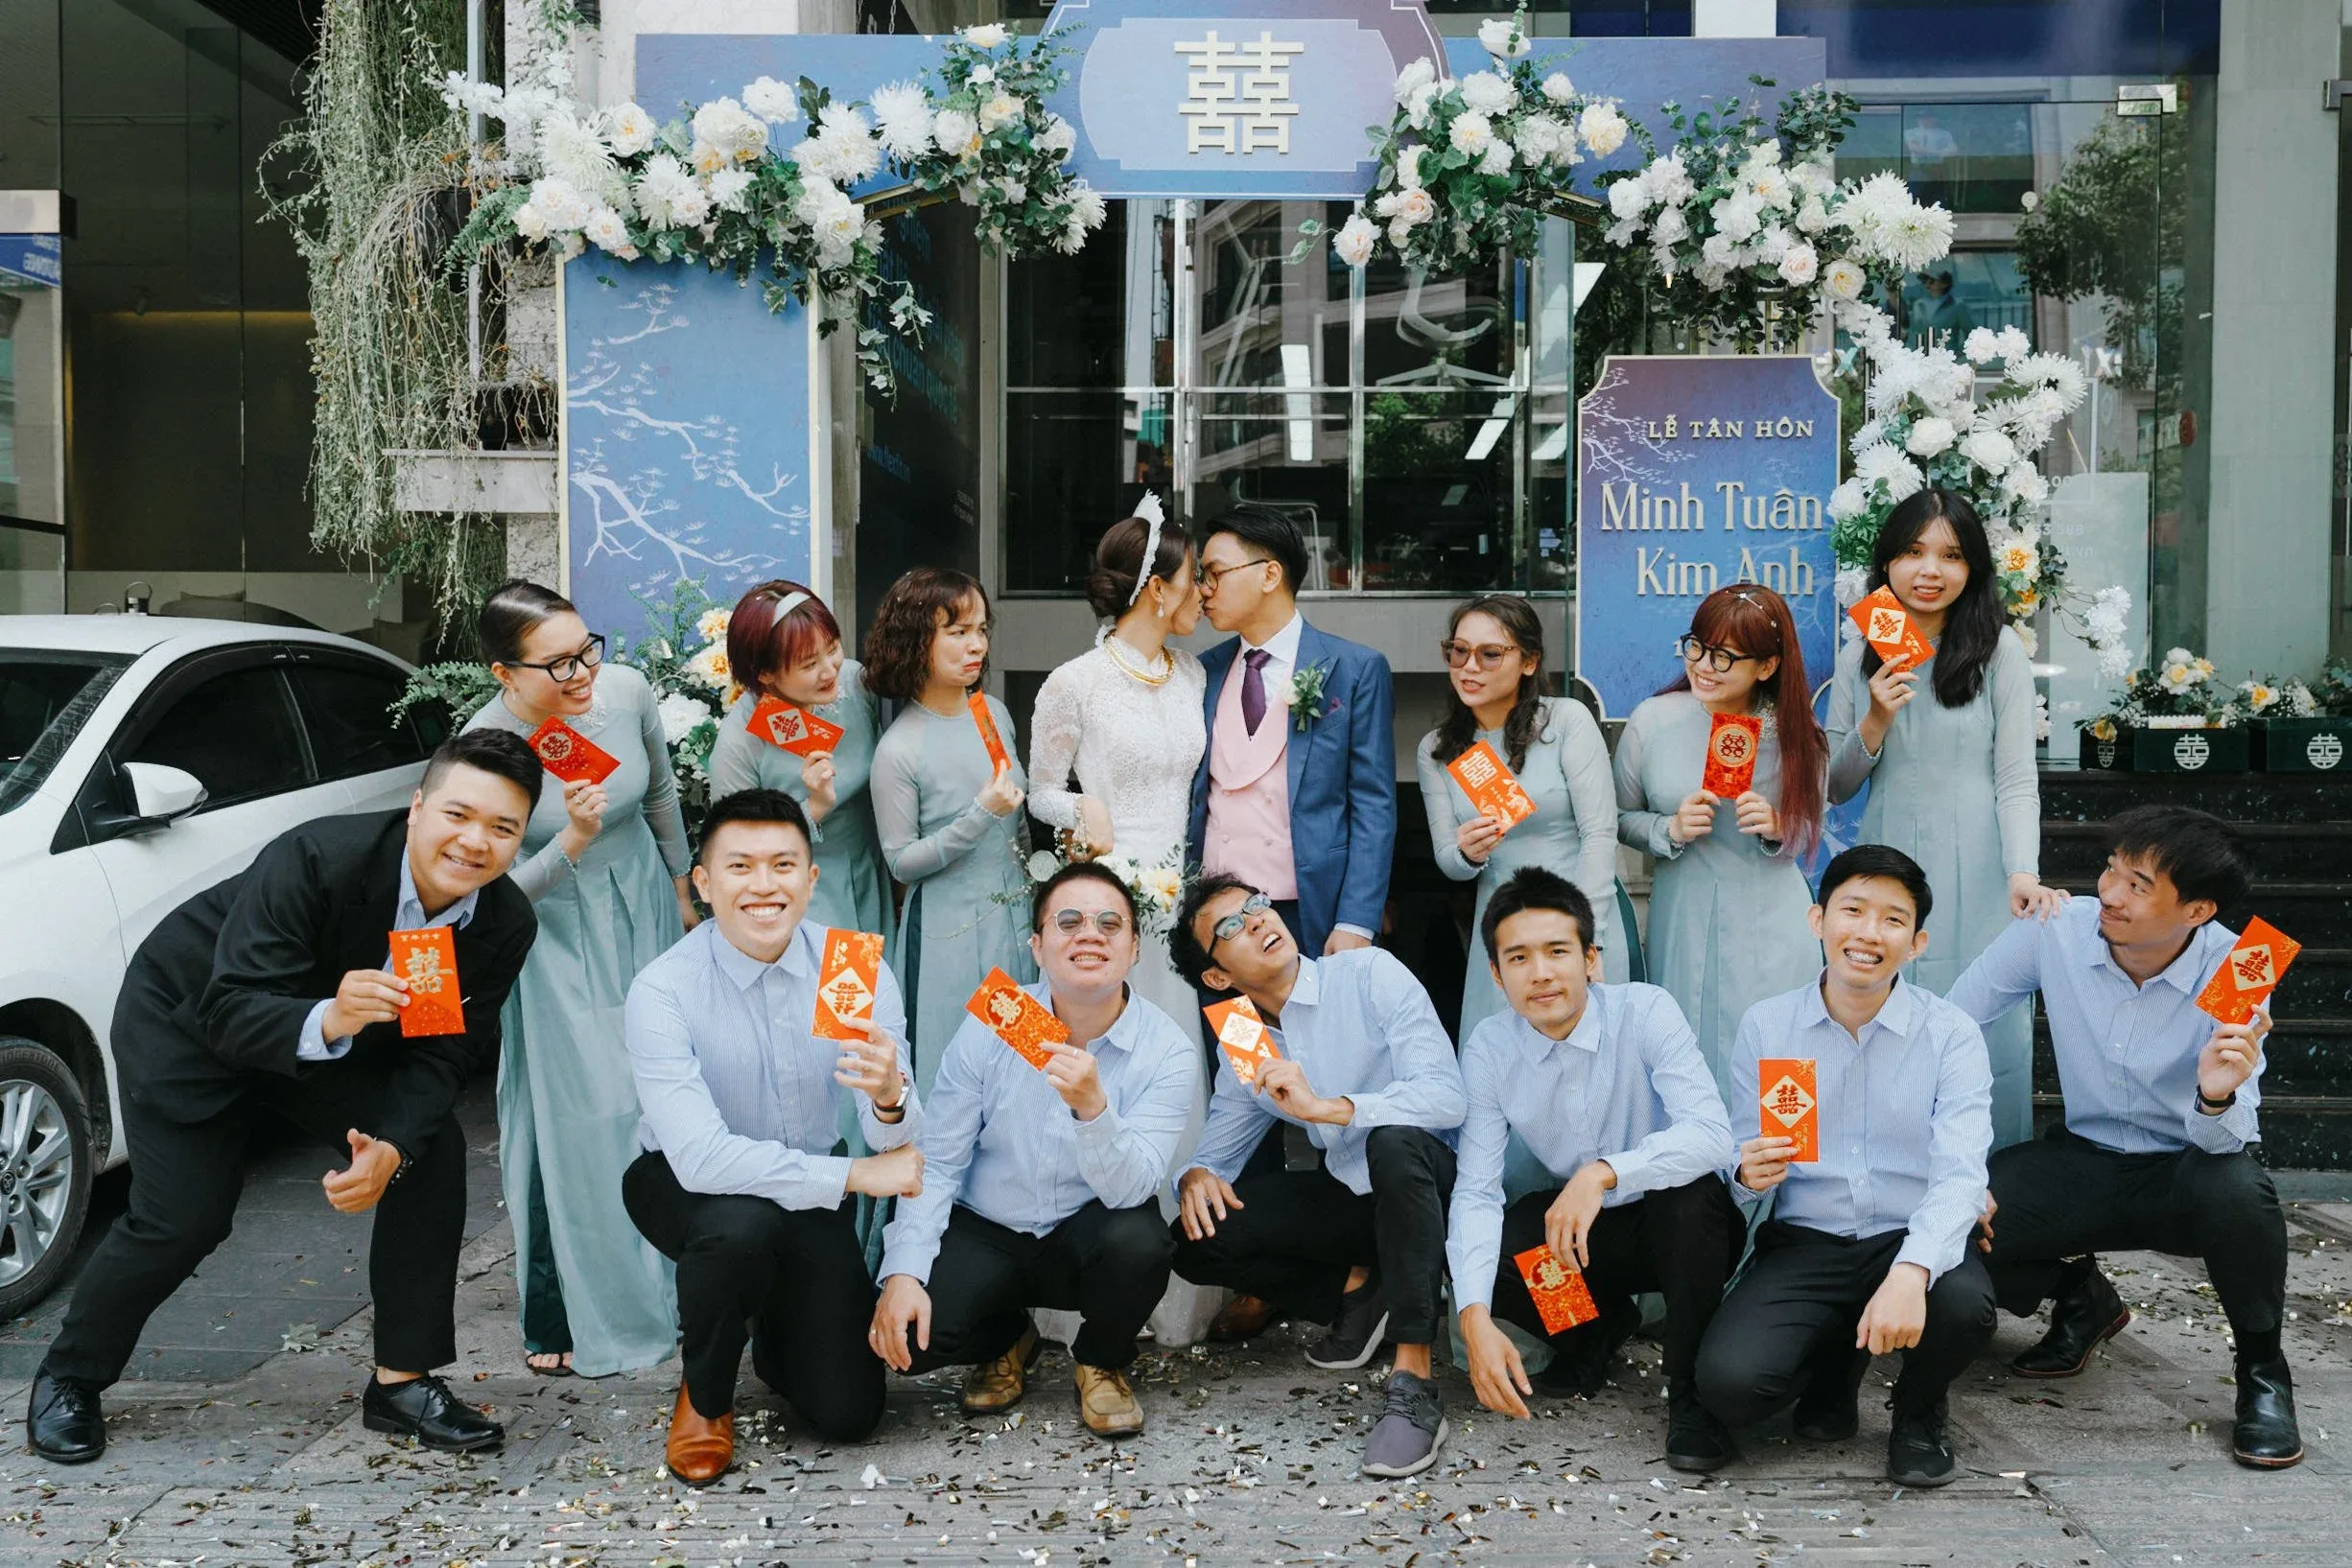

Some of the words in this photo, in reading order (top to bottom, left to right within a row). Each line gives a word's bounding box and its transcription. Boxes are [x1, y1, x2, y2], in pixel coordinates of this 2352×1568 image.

[1173, 30, 1305, 155] 囍
[1648, 413, 1679, 439] LỄ
[1690, 416, 1743, 439] TÂN
[1753, 415, 1814, 439] HÔN
[1600, 480, 1705, 532] Minh
[1715, 480, 1823, 532] Tuân
[1635, 546, 1719, 597] Kim
[1735, 545, 1815, 597] Anh
